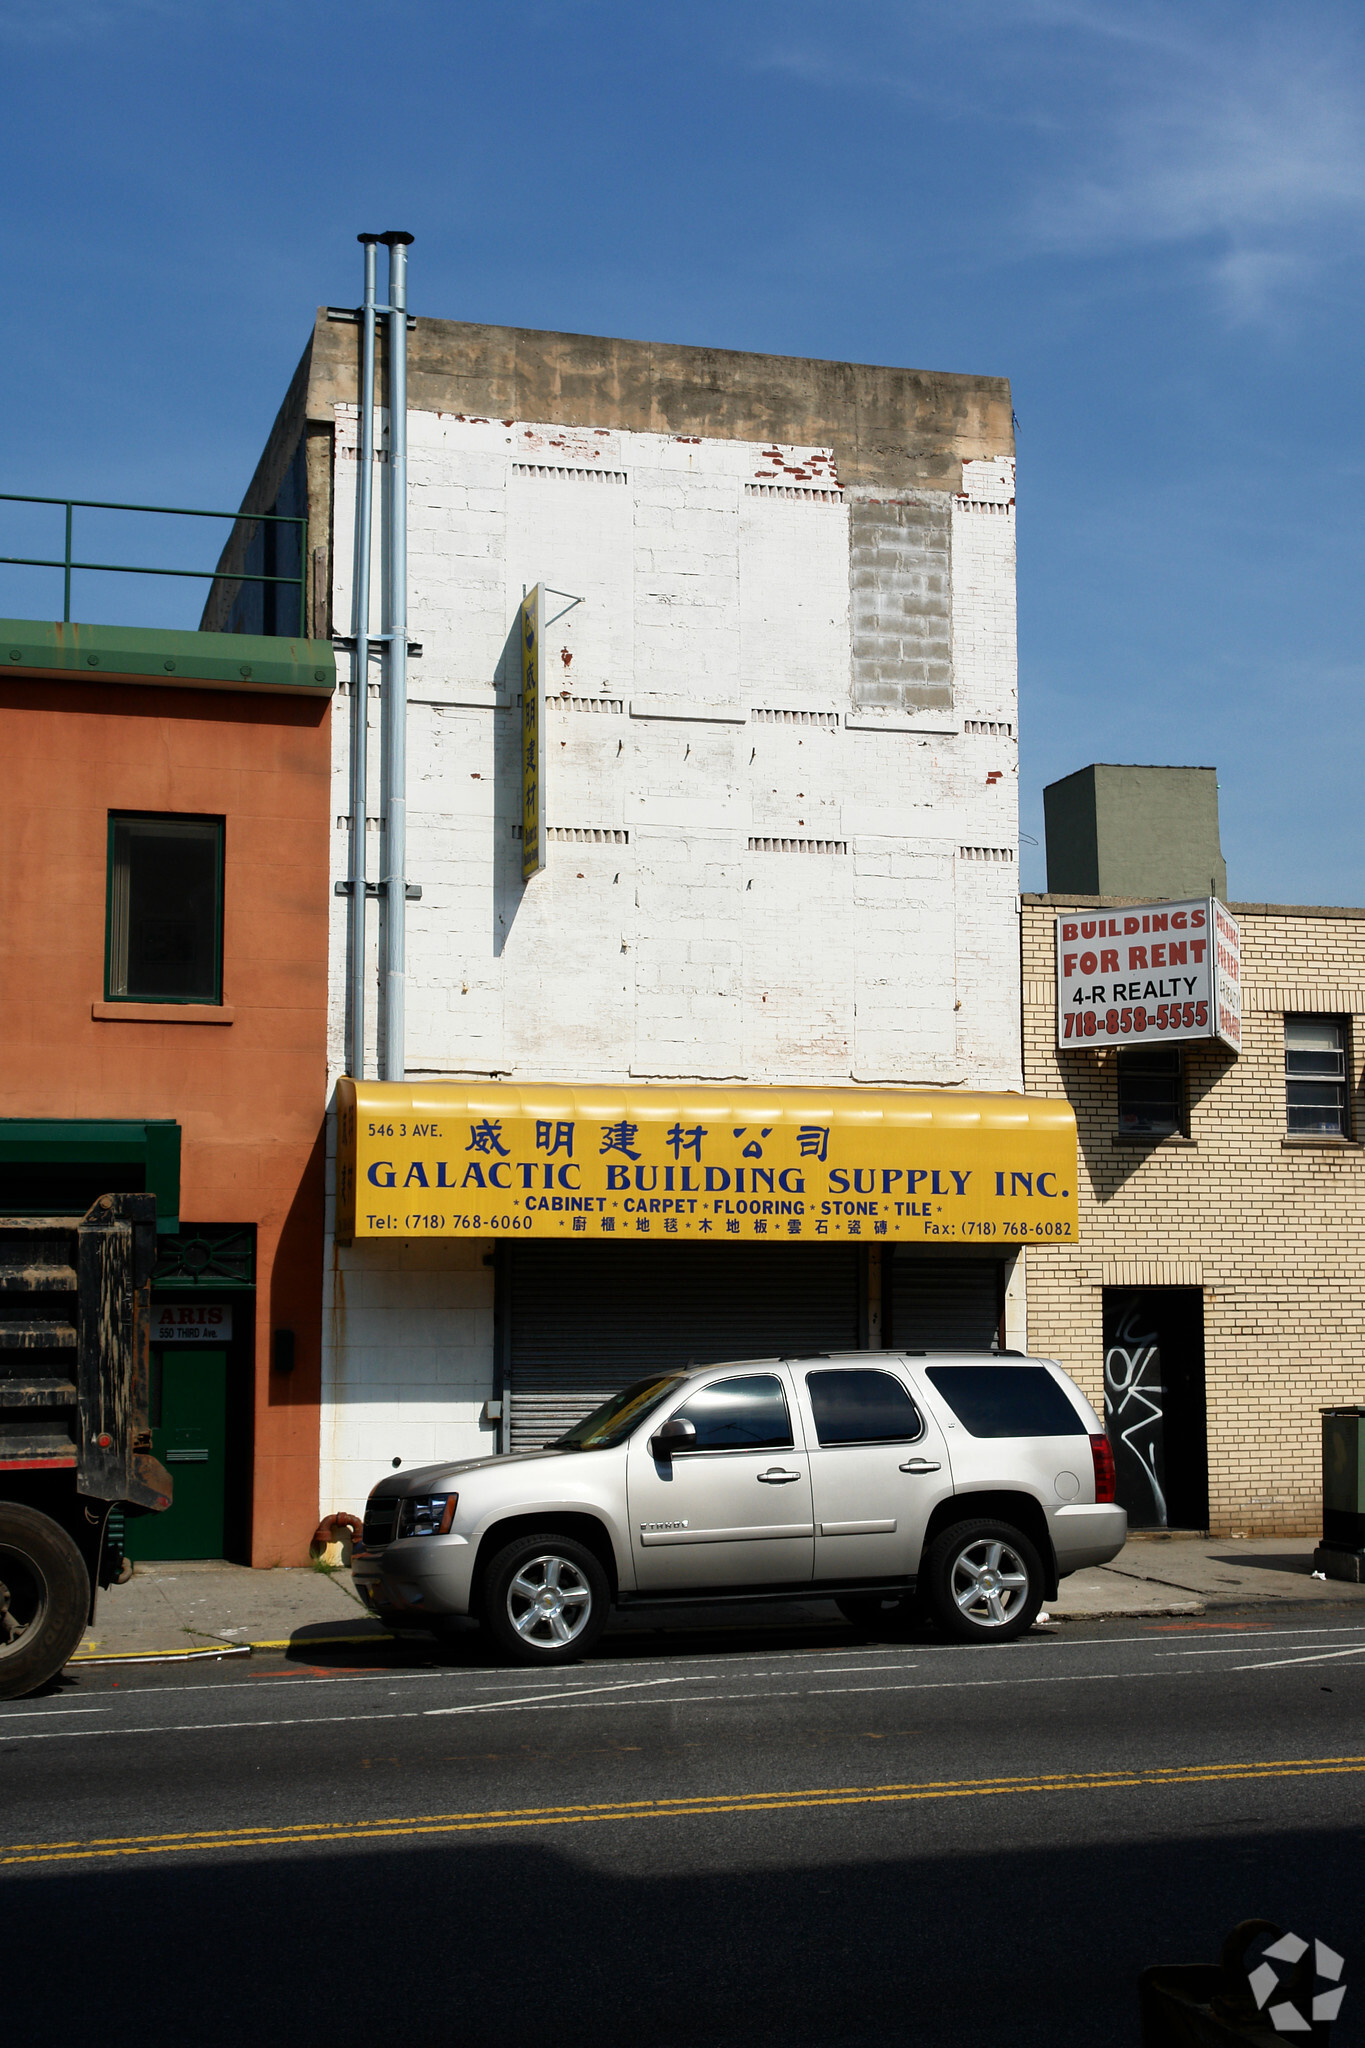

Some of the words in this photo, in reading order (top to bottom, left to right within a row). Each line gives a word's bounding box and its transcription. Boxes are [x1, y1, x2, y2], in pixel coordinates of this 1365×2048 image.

[1063, 910, 1205, 941] BUILDINGS
[1064, 949, 1120, 977] FOR
[1128, 939, 1207, 970] RENT
[1073, 986, 1106, 1005] 4-R
[1113, 976, 1198, 1002] REALTY
[1063, 1000, 1208, 1038] 718-858-5555
[369, 1124, 393, 1136] 546
[400, 1124, 406, 1136] 3
[413, 1124, 442, 1137] AVE.
[465, 1119, 830, 1163] 威明建材公司
[367, 1161, 581, 1188] GALACTIC
[606, 1165, 805, 1193] BUILDING
[829, 1169, 971, 1195] SUPPLY
[995, 1172, 1068, 1197] INC.
[525, 1196, 606, 1211] CABINET
[624, 1198, 697, 1213] CARPET
[714, 1200, 804, 1215] FLOORING
[822, 1201, 878, 1215] STONE
[895, 1202, 931, 1216] TILE
[367, 1215, 397, 1229] Tel:
[406, 1215, 445, 1228] (718)
[453, 1215, 532, 1229] 768-6060
[925, 1221, 954, 1235] Fax:
[962, 1222, 996, 1235] (718)
[1003, 1222, 1071, 1235] 768-6082
[158, 1308, 223, 1324] ARIS
[159, 1328, 174, 1339] 550
[177, 1328, 200, 1338] THIRD
